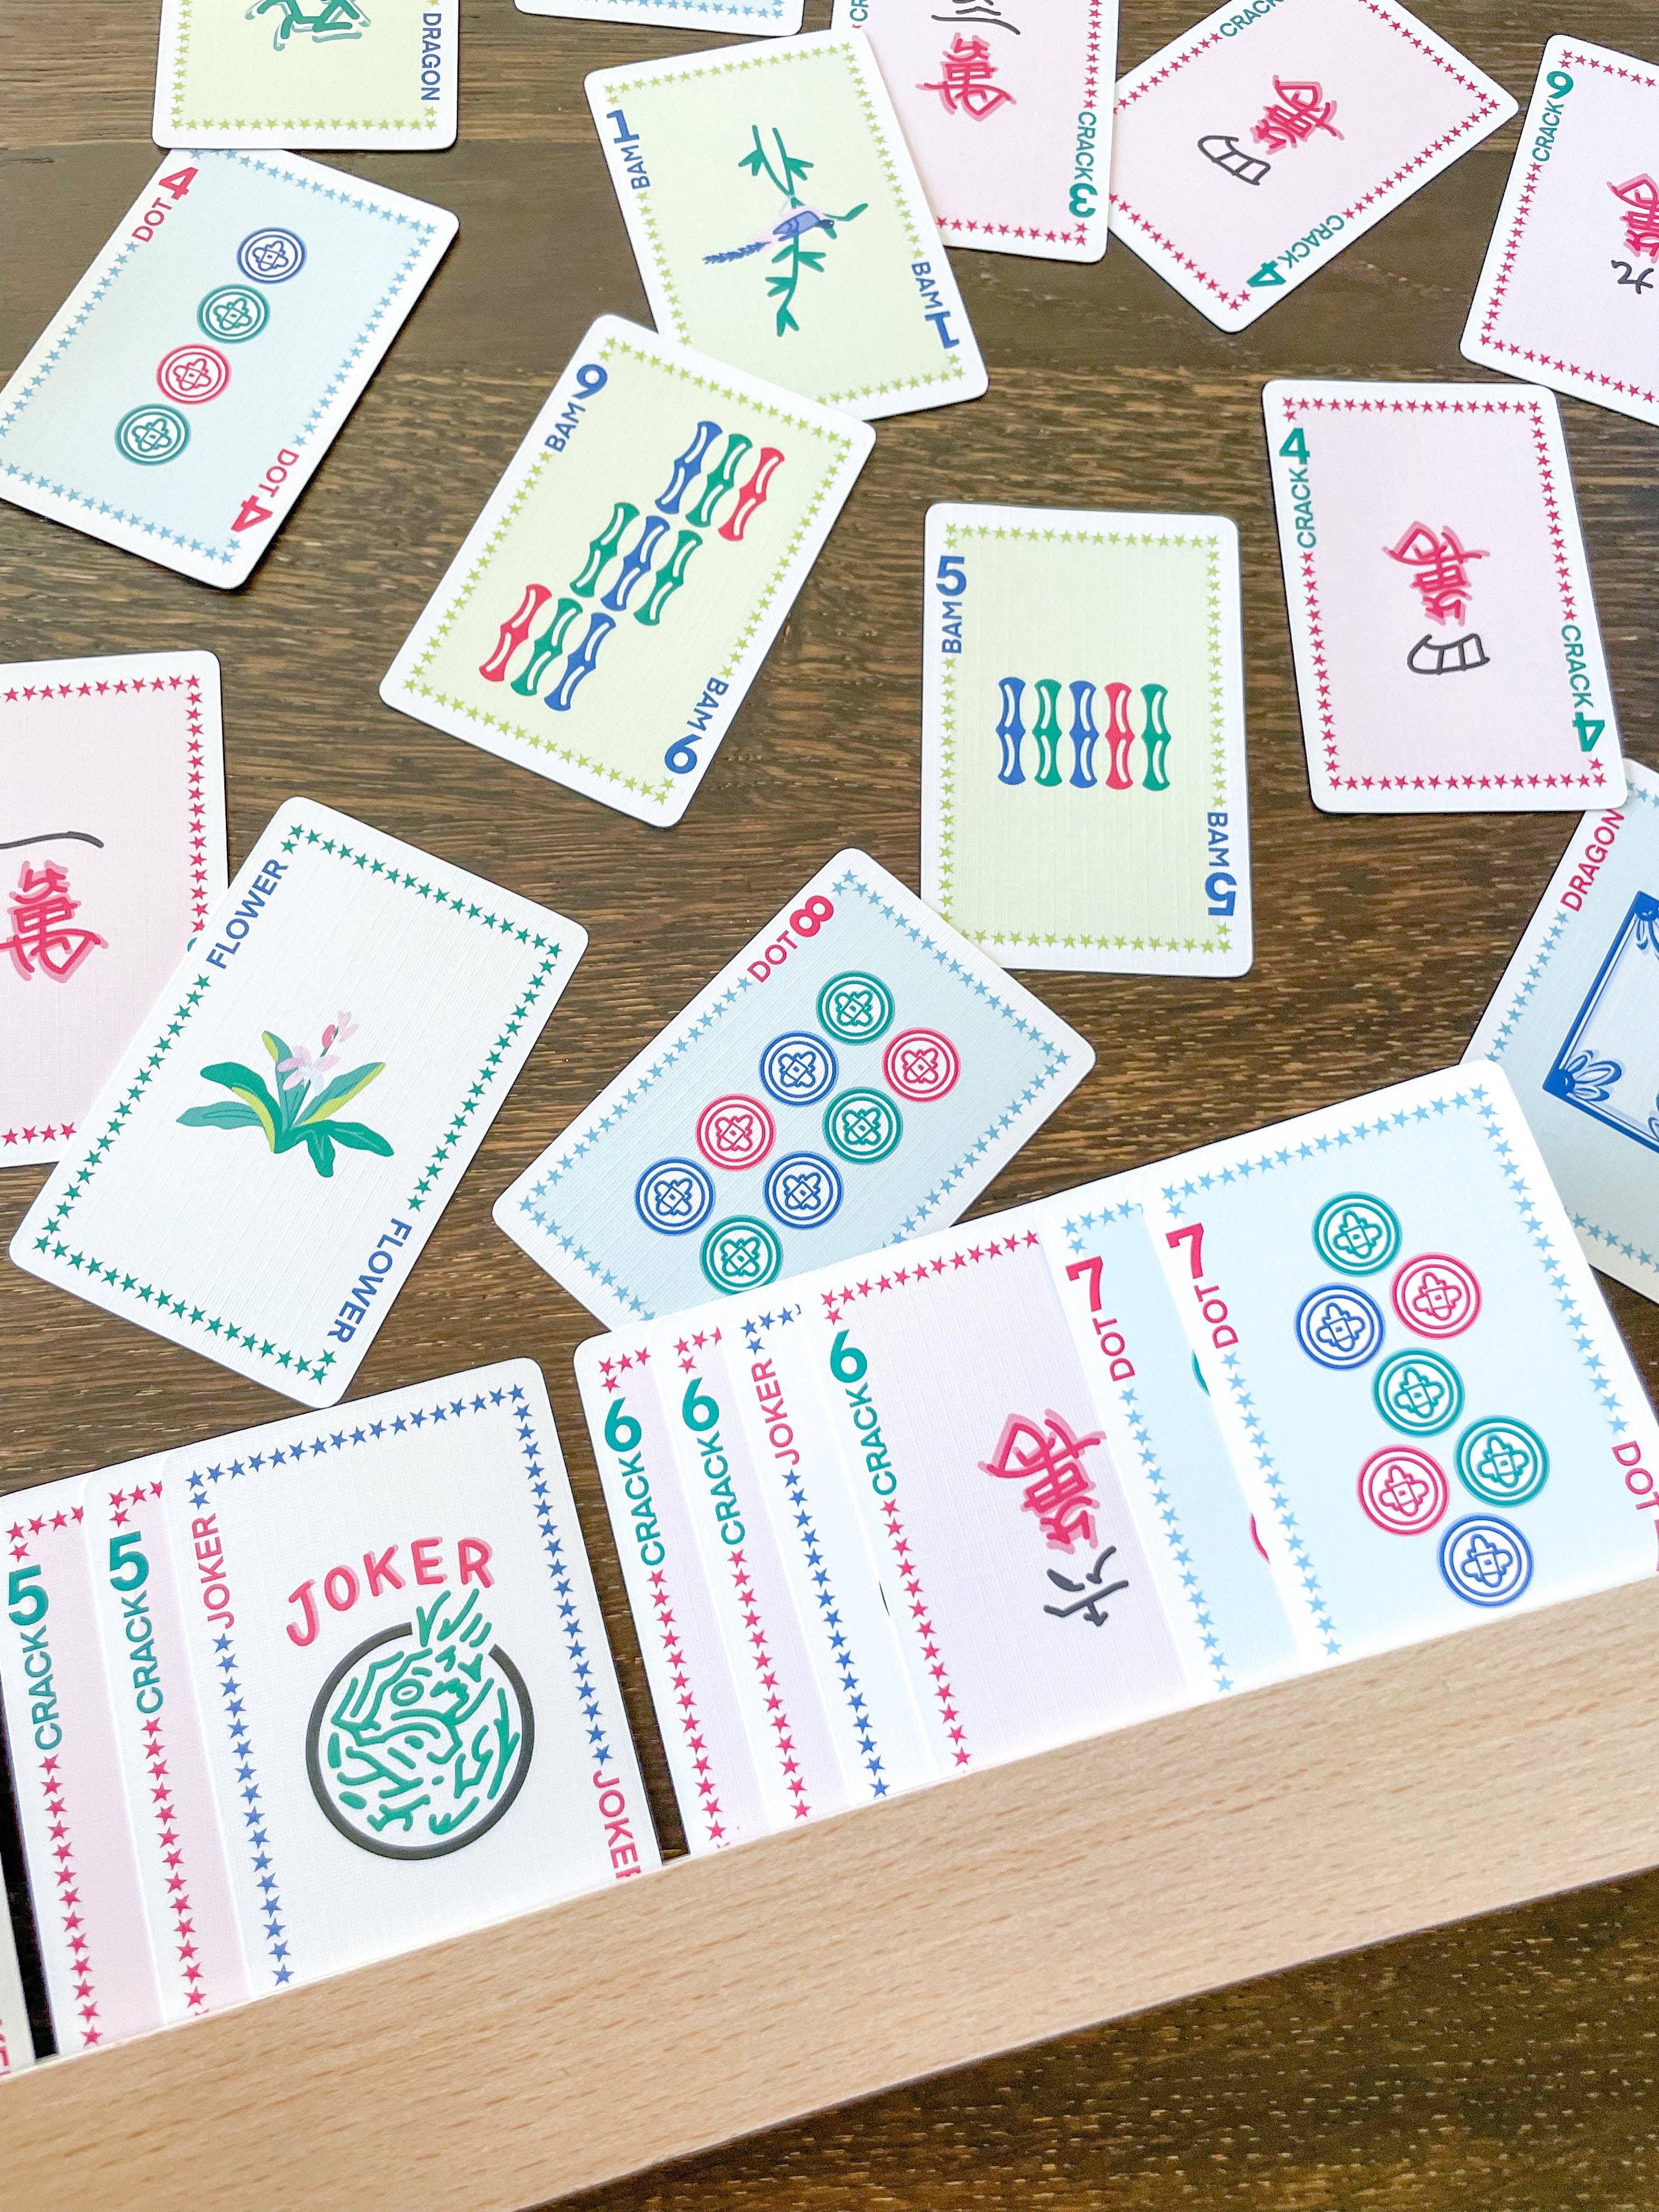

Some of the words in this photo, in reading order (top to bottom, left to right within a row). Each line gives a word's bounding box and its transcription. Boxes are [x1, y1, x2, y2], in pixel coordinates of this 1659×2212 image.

[421, 13, 442, 101] DRAGON
[1545, 70, 1575, 100] 9
[606, 109, 640, 144] 1
[1074, 111, 1097, 182] CRACK
[1531, 101, 1564, 162] CRACK
[621, 145, 651, 189] BAM
[132, 198, 172, 243] DOT
[159, 167, 199, 201] 4
[1069, 183, 1098, 218] 3
[1283, 214, 1345, 269] CRACK
[911, 261, 943, 310] BAM
[1246, 259, 1287, 288] 4
[924, 311, 960, 349] 1
[543, 399, 587, 453] BAM
[575, 363, 608, 400] 9
[258, 448, 300, 498] DOT
[1278, 427, 1310, 465] 4
[230, 495, 273, 533] 4
[1290, 467, 1317, 548] CRACK
[935, 554, 967, 597] 5
[940, 601, 963, 654] BAM
[1560, 624, 1594, 708] CRACK
[686, 676, 730, 731] BAM
[1572, 711, 1605, 752] 4
[664, 733, 702, 774] 9
[1207, 811, 1231, 867] BAM
[1559, 809, 1624, 911] DRAGON
[206, 858, 289, 969] FLOWER
[1204, 871, 1237, 917] 5
[747, 930, 793, 984] DOT
[788, 894, 834, 938] 8
[328, 1218, 413, 1342] FLOWER
[1165, 1222, 1205, 1280] 7
[1064, 1255, 1104, 1313] 7
[1193, 1284, 1240, 1350] DOT
[829, 1329, 868, 1384] 6
[1093, 1317, 1136, 1383] DOT
[603, 1397, 642, 1453] 6
[681, 1377, 720, 1432] 6
[750, 1357, 801, 1466] JOKER
[844, 1383, 897, 1497] CRACK
[617, 1451, 665, 1566] CRACK
[696, 1430, 746, 1546] CRACK
[109, 1530, 150, 1591] 5
[191, 1513, 235, 1629] JOKER
[8, 1564, 49, 1626] 5
[286, 1536, 495, 1646] JOKER
[121, 1589, 164, 1714] CRACK
[20, 1624, 63, 1750] CRACK
